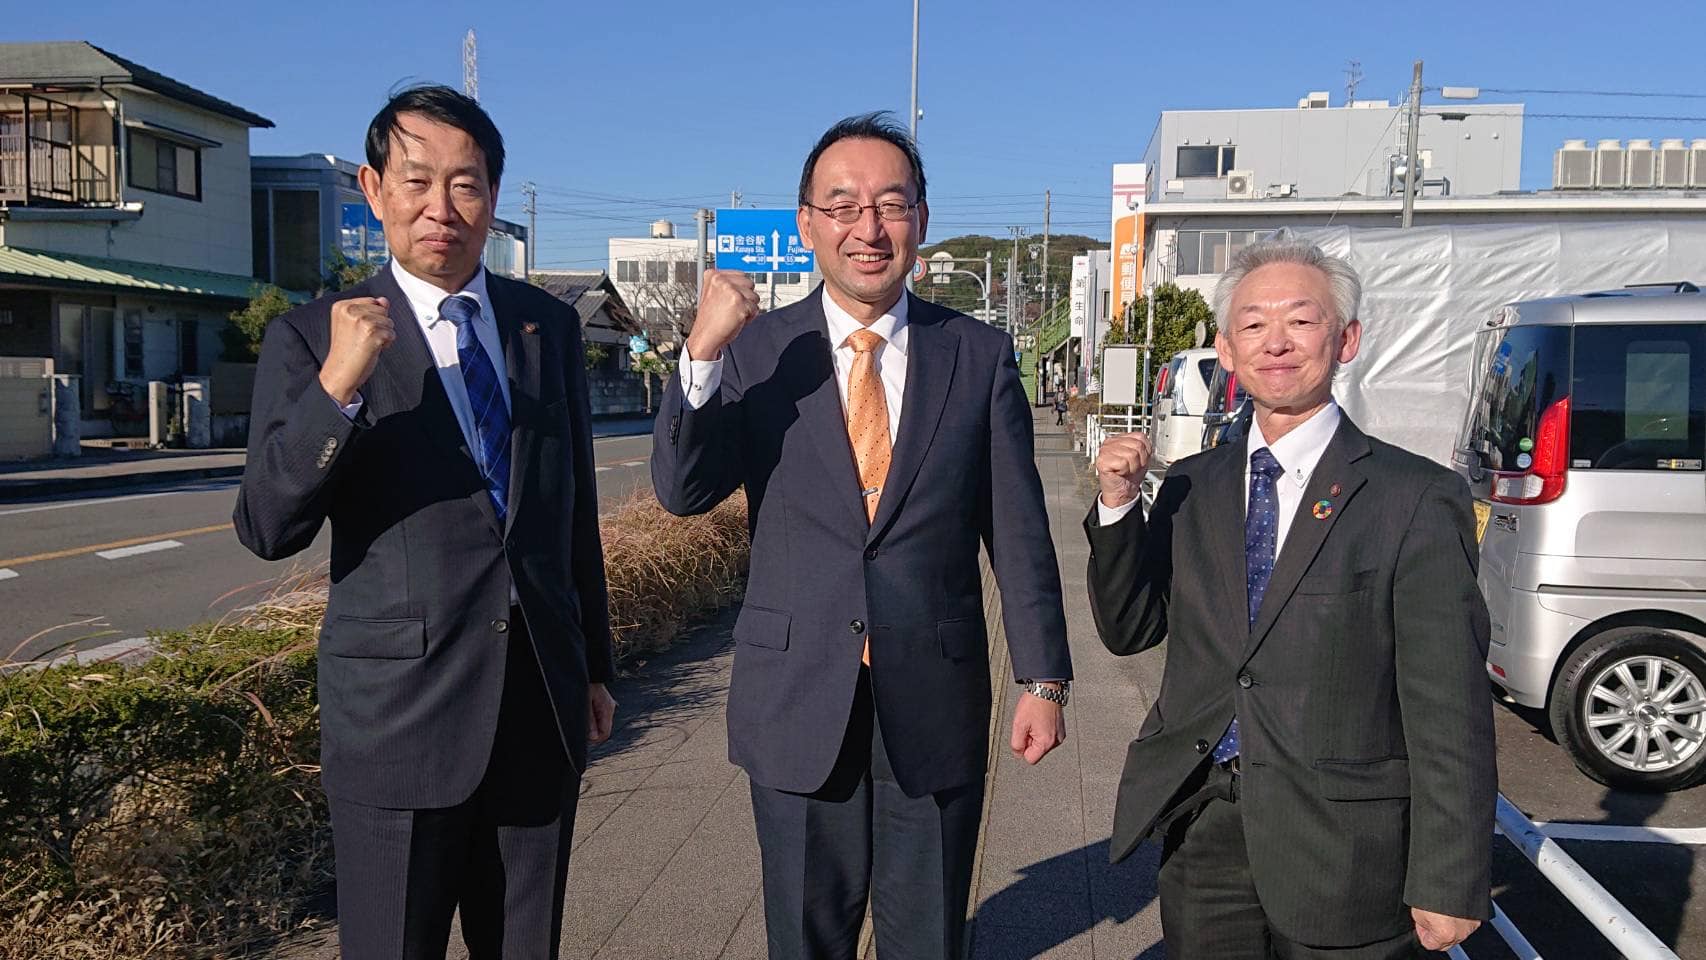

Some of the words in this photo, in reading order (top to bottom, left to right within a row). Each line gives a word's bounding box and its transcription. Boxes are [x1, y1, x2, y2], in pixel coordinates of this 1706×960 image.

[735, 235, 765, 246] 金谷駅
[1074, 279, 1085, 326] 第一生命
